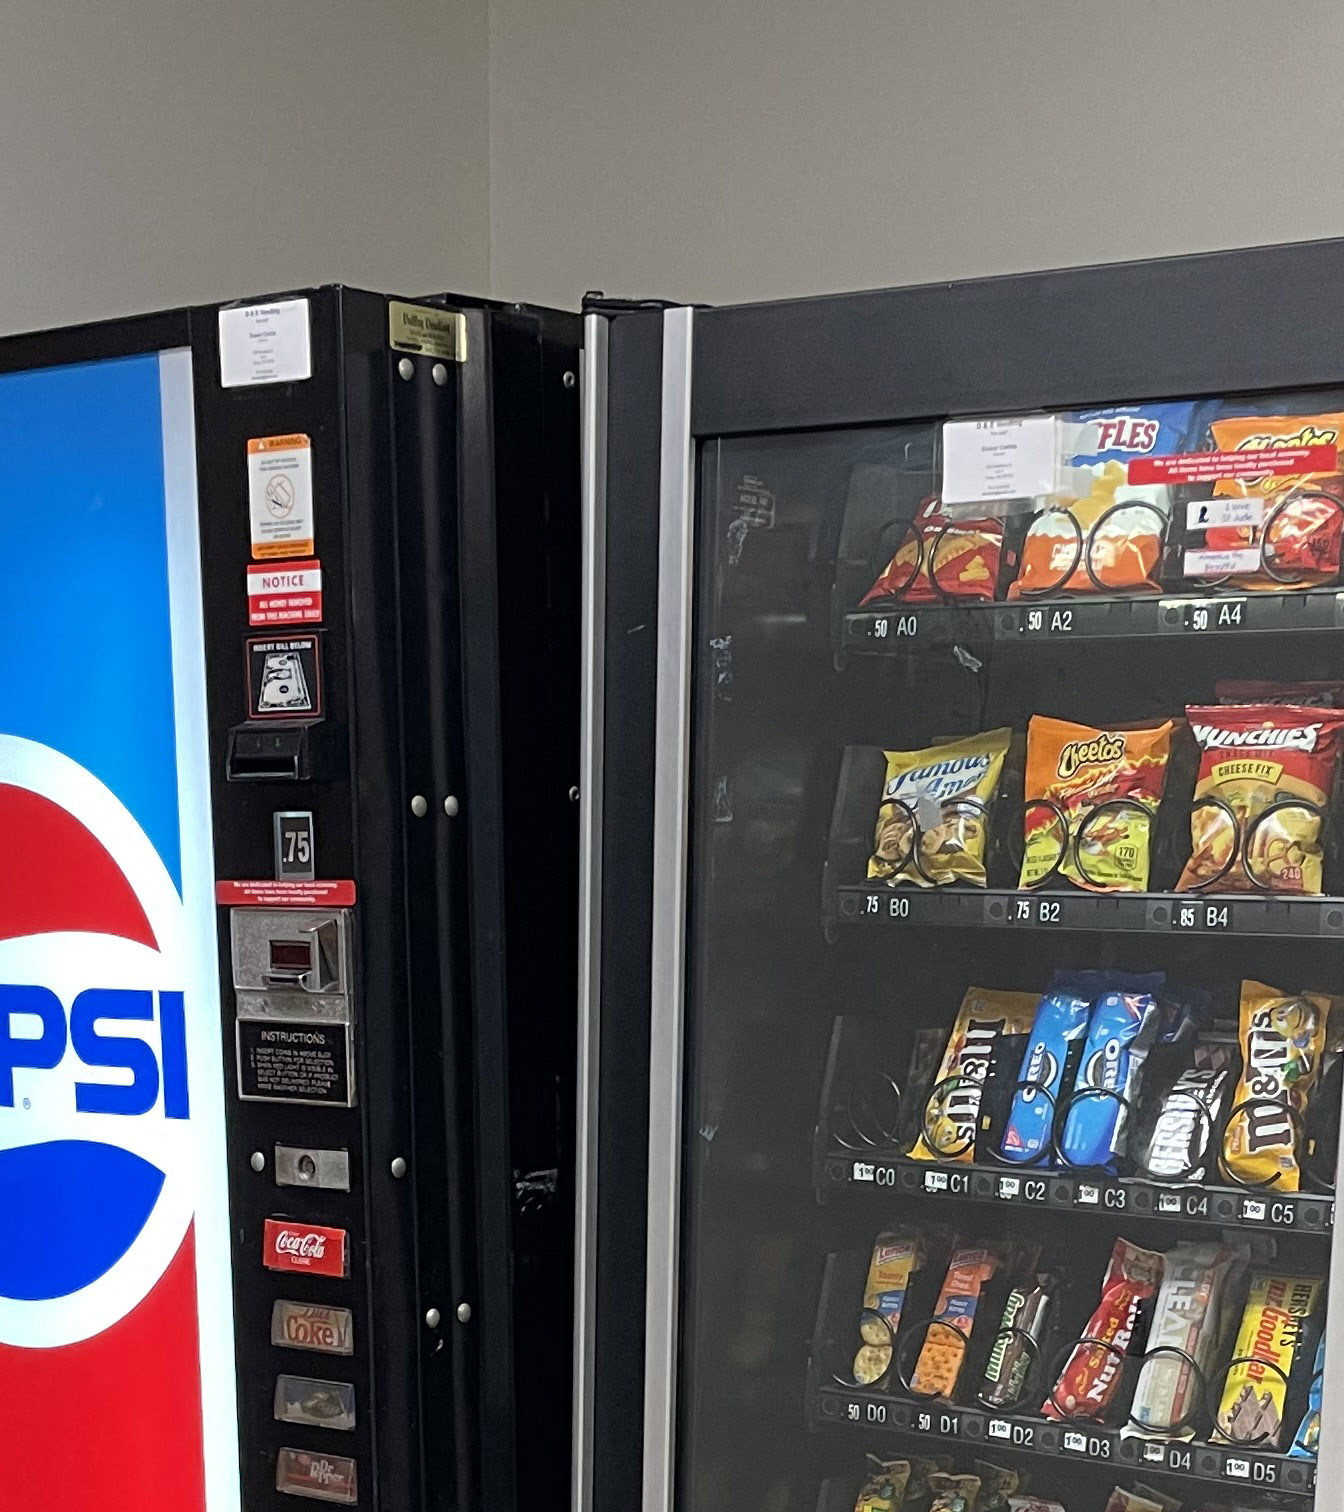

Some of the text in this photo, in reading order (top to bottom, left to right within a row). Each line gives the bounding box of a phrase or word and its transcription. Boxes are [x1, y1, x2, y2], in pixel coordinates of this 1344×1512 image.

[262, 575, 304, 588] NOTICE
[1050, 611, 1073, 632] A2
[1218, 603, 1242, 625] A4
[896, 616, 917, 636] A0
[1192, 722, 1323, 753] MUNCHIES
[1058, 734, 1125, 778] Cheetos
[887, 752, 990, 796] Famous
[1218, 763, 1274, 777] CHEESE FIX
[1118, 847, 1135, 858] 170
[1282, 869, 1301, 880] 240
[890, 898, 909, 917] B0
[1040, 903, 1060, 922] B2
[1207, 907, 1228, 927] B4
[261, 1031, 325, 1044] INSTRUCTIONS
[875, 1168, 895, 1186] C0
[950, 1174, 969, 1193] C1
[1025, 1182, 1046, 1200] C2
[1105, 1189, 1126, 1208] C3
[1186, 1196, 1208, 1216] C4
[1271, 1204, 1294, 1224] C5
[286, 1315, 334, 1346] Coke
[985, 1331, 1014, 1382] Milky
[1000, 1291, 1025, 1330] Way
[1087, 1349, 1121, 1403] Nut
[867, 1405, 886, 1423] D0
[940, 1417, 958, 1434] D1
[1013, 1429, 1034, 1446] D2
[1089, 1439, 1110, 1457] D3
[321, 1459, 334, 1471] Dr
[1169, 1451, 1191, 1470] D4
[310, 1462, 344, 1484] Pepper
[1253, 1463, 1276, 1482] D5
